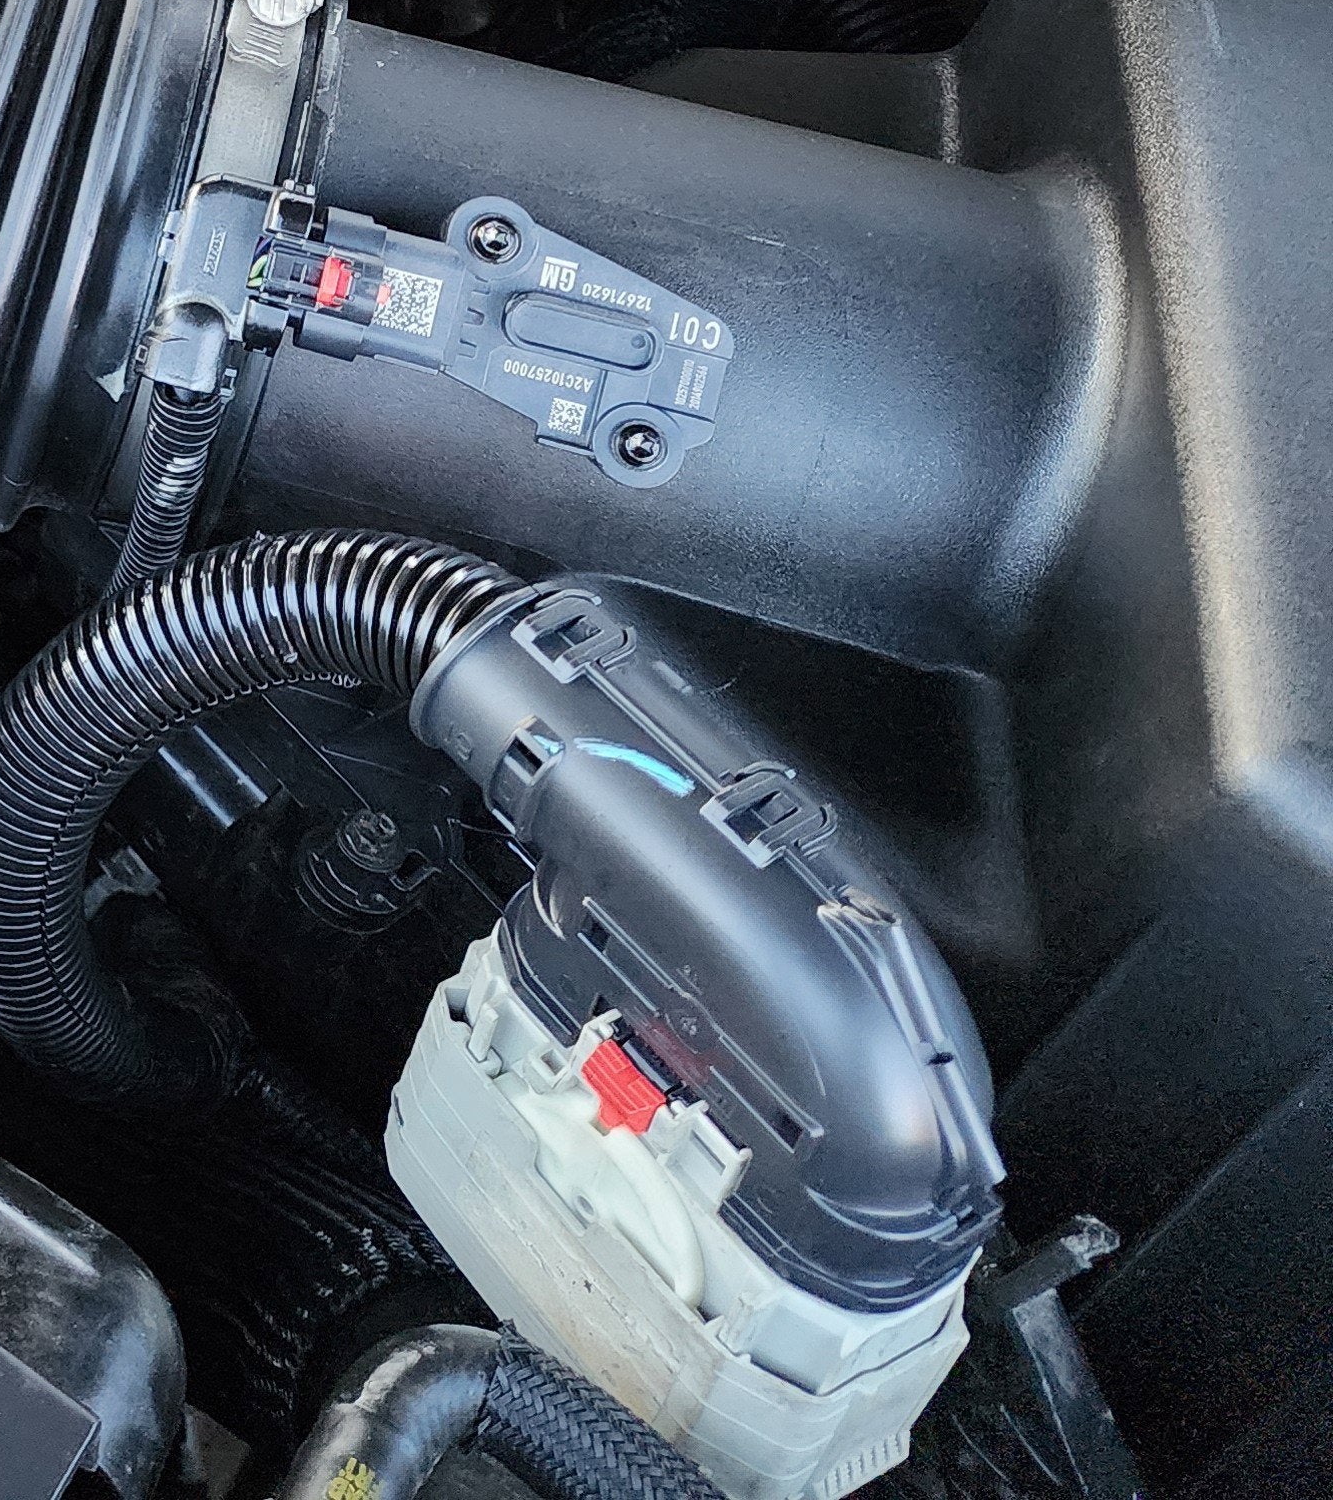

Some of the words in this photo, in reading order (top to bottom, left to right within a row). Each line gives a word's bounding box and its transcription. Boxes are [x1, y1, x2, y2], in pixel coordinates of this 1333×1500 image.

[539, 257, 578, 292] GM
[582, 282, 652, 312] 12671620
[669, 312, 721, 350] C01
[504, 359, 594, 393] A2C10257000
